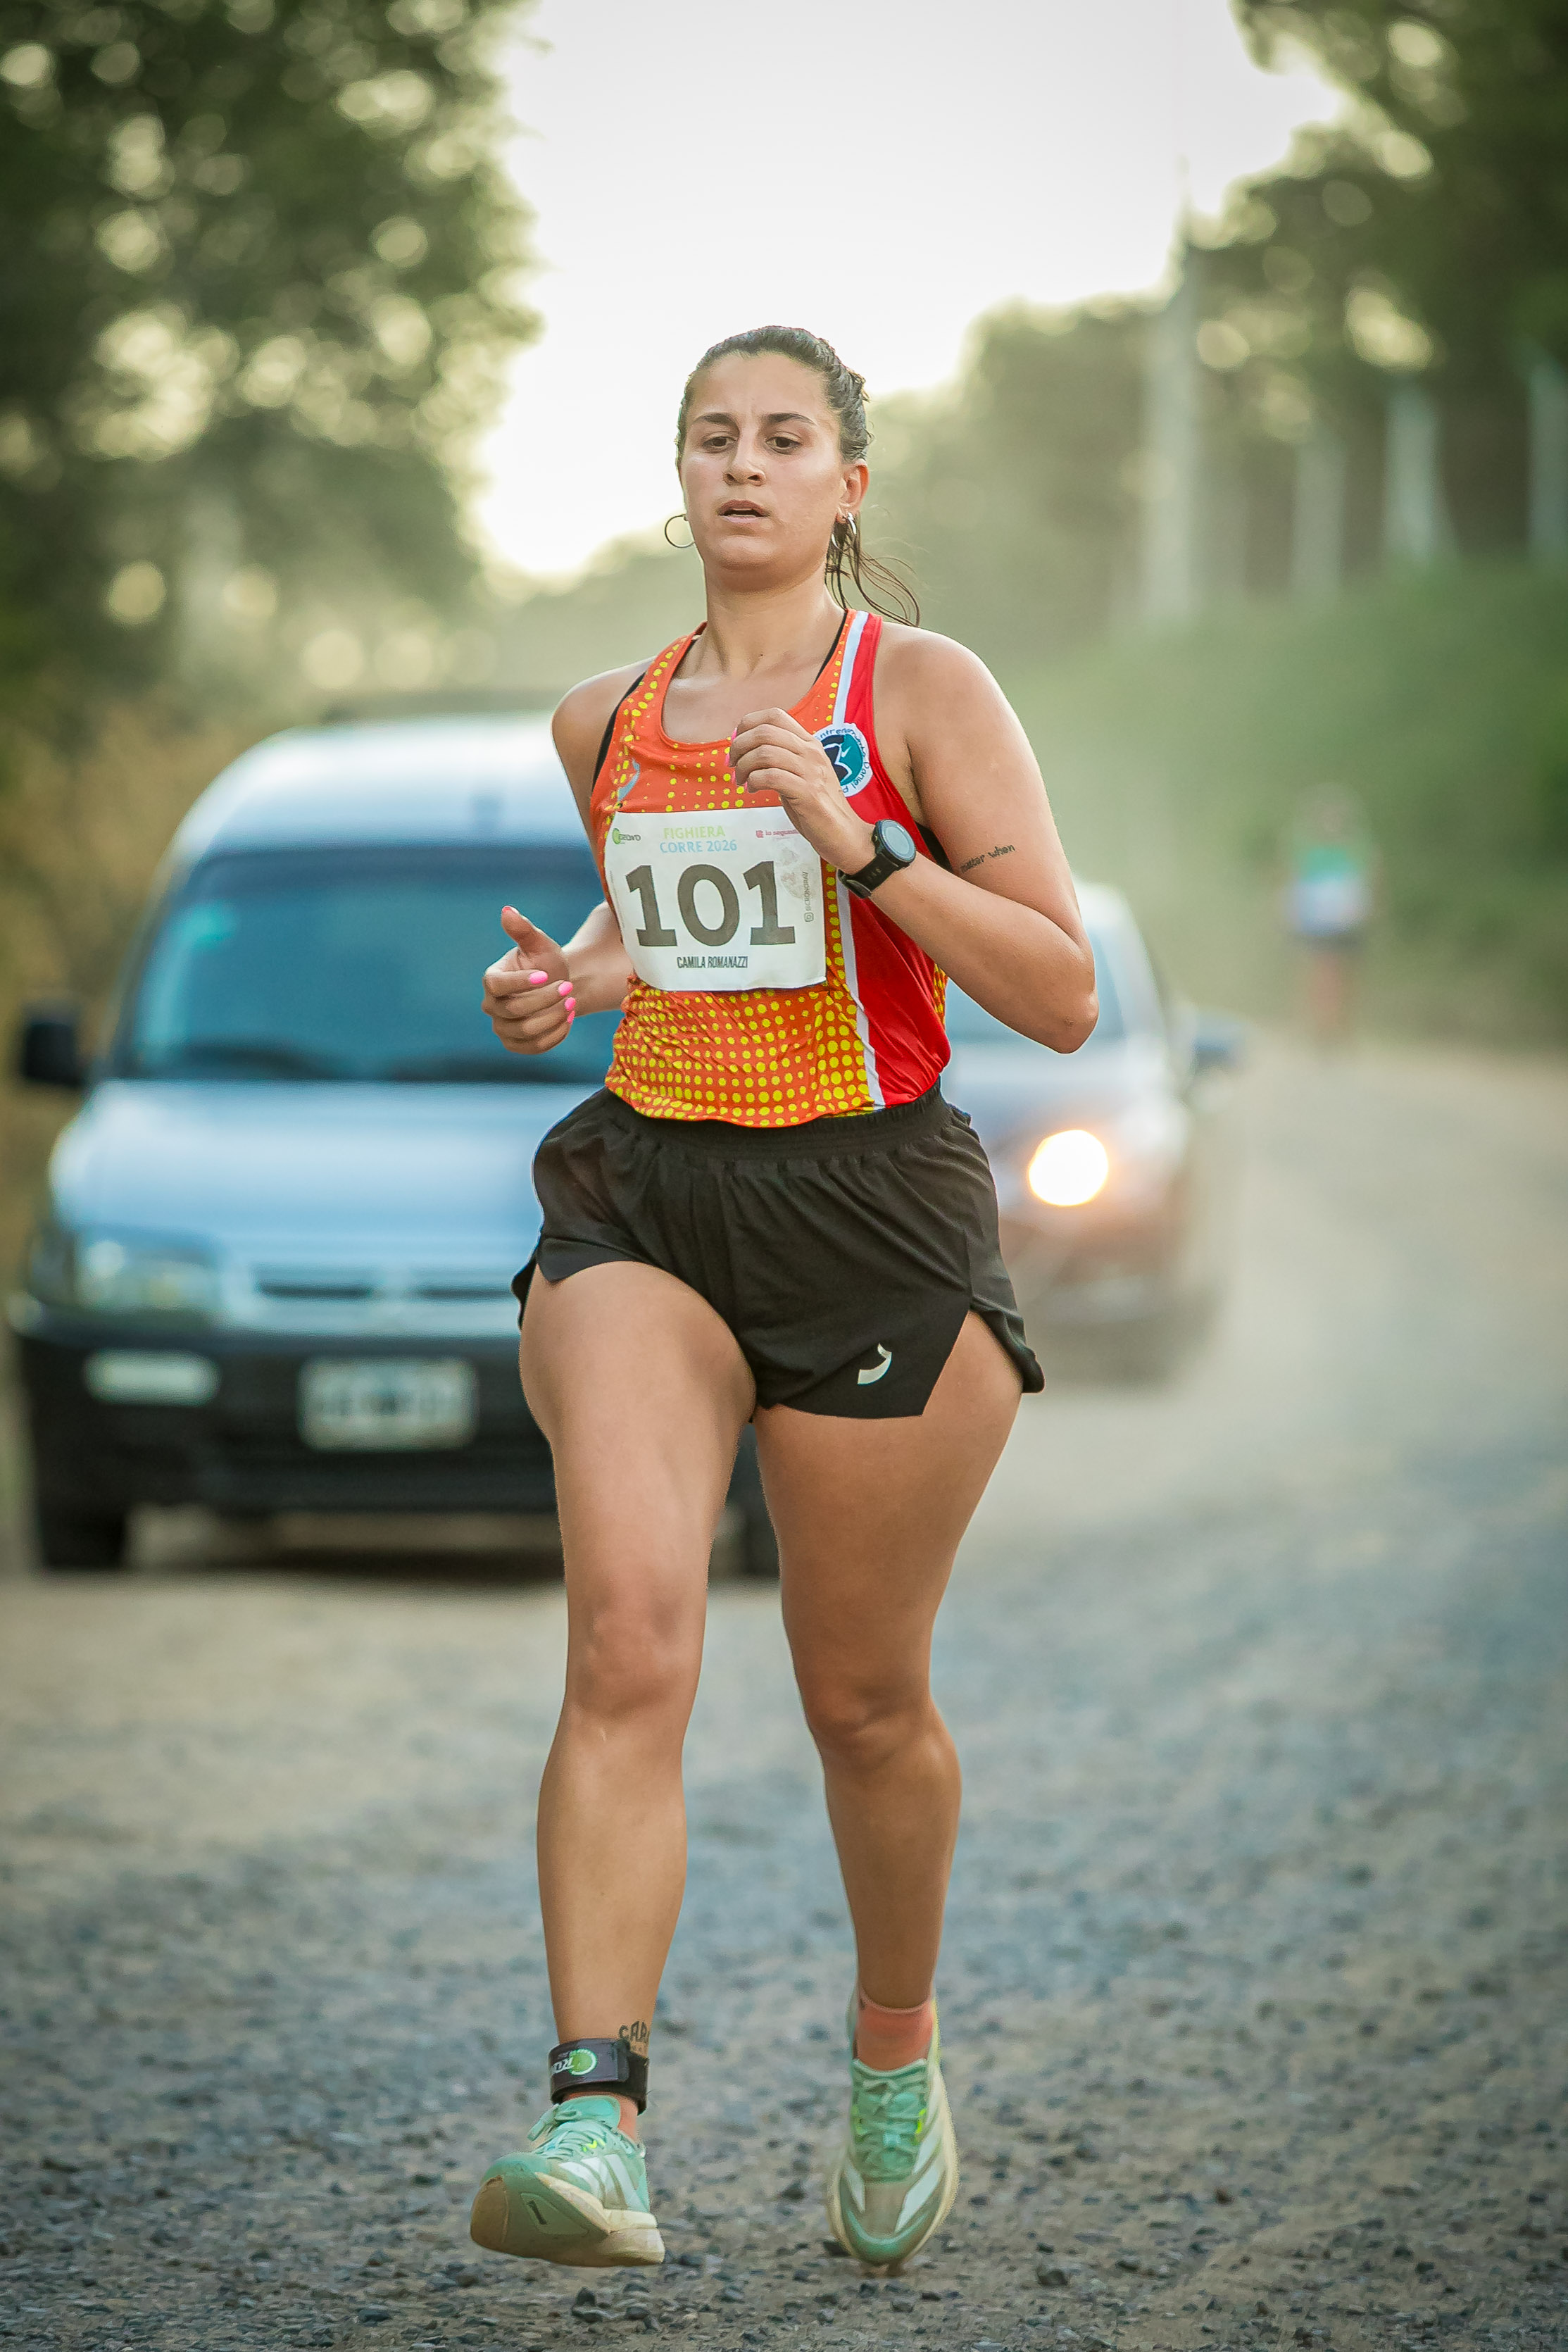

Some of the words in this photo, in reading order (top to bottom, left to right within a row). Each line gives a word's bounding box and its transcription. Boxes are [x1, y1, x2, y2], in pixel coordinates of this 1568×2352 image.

[663, 825, 726, 839] FIGHIERA
[660, 841, 703, 853] CORRE
[706, 839, 737, 852] 2026
[625, 861, 796, 947] 101
[677, 956, 706, 968] CAMILA
[707, 956, 748, 968] ROMANAZZI
